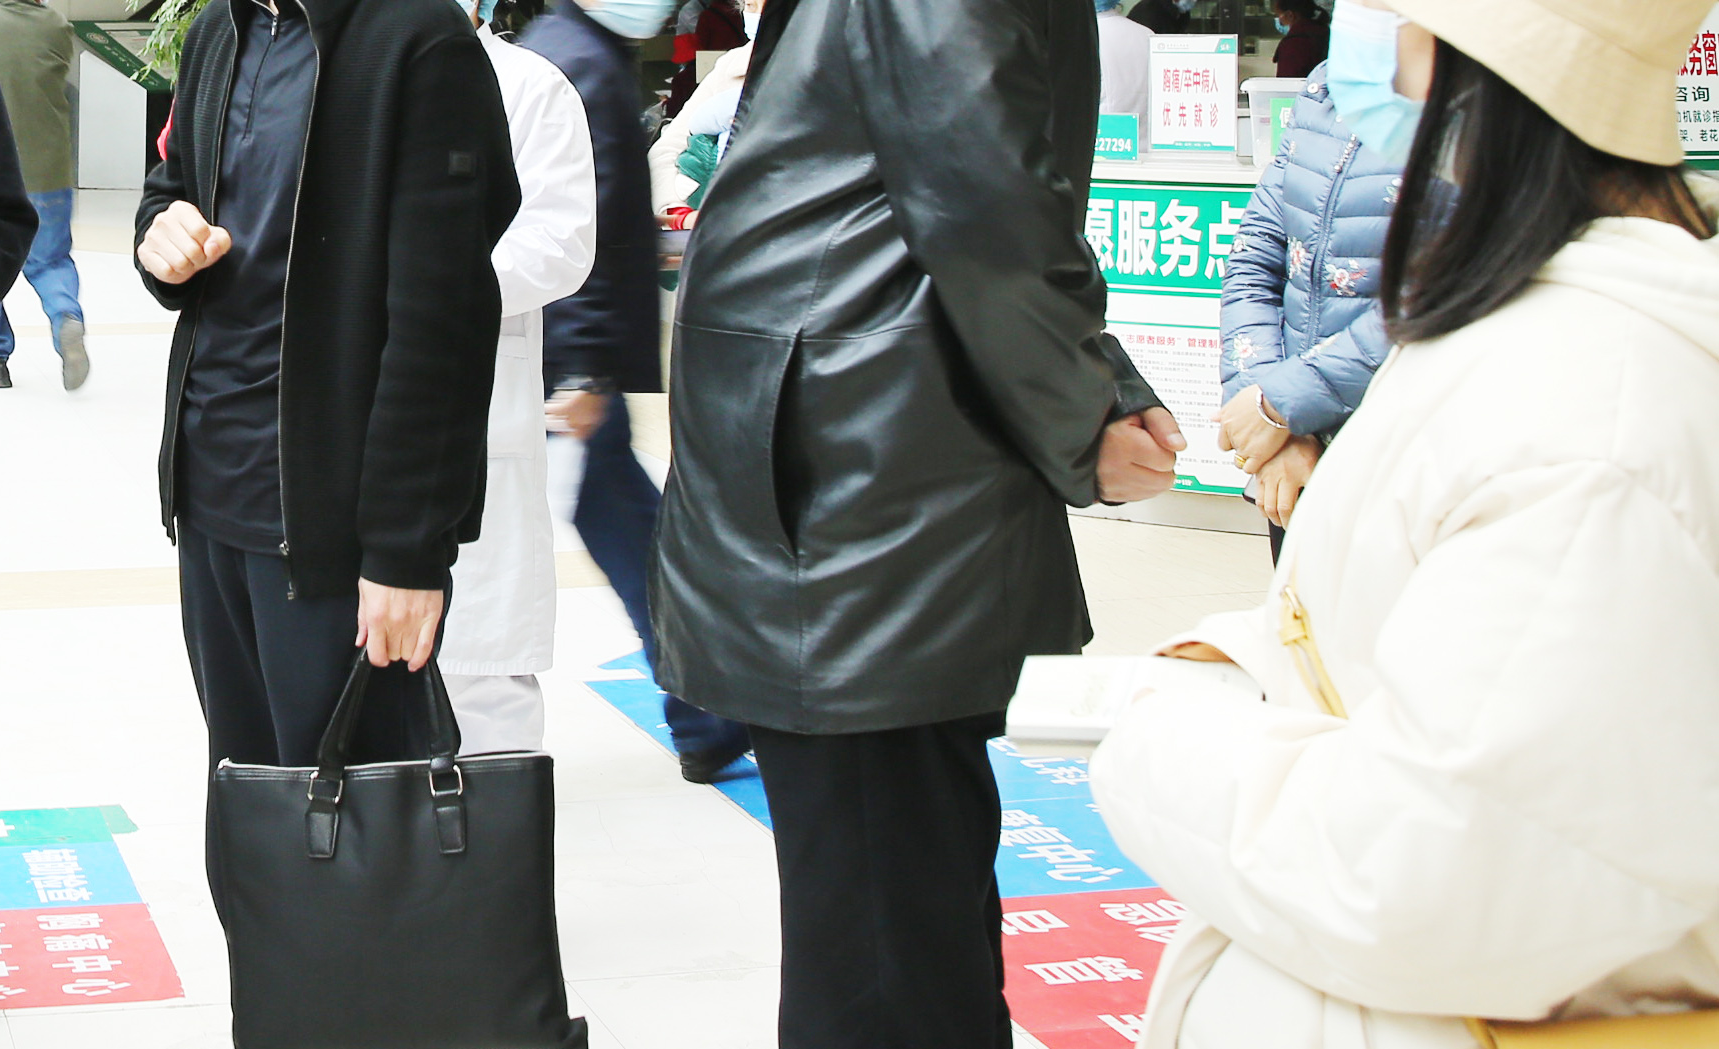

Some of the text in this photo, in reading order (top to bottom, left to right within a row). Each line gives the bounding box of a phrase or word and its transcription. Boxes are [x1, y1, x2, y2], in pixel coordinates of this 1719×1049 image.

[1678, 30, 1719, 76] 务窗
[1163, 67, 1219, 93] 胸痛/卒中病人
[1163, 102, 1219, 127] 优先就诊
[22, 848, 93, 904] 辅助检查
[36, 912, 131, 997] 胸痛中心
